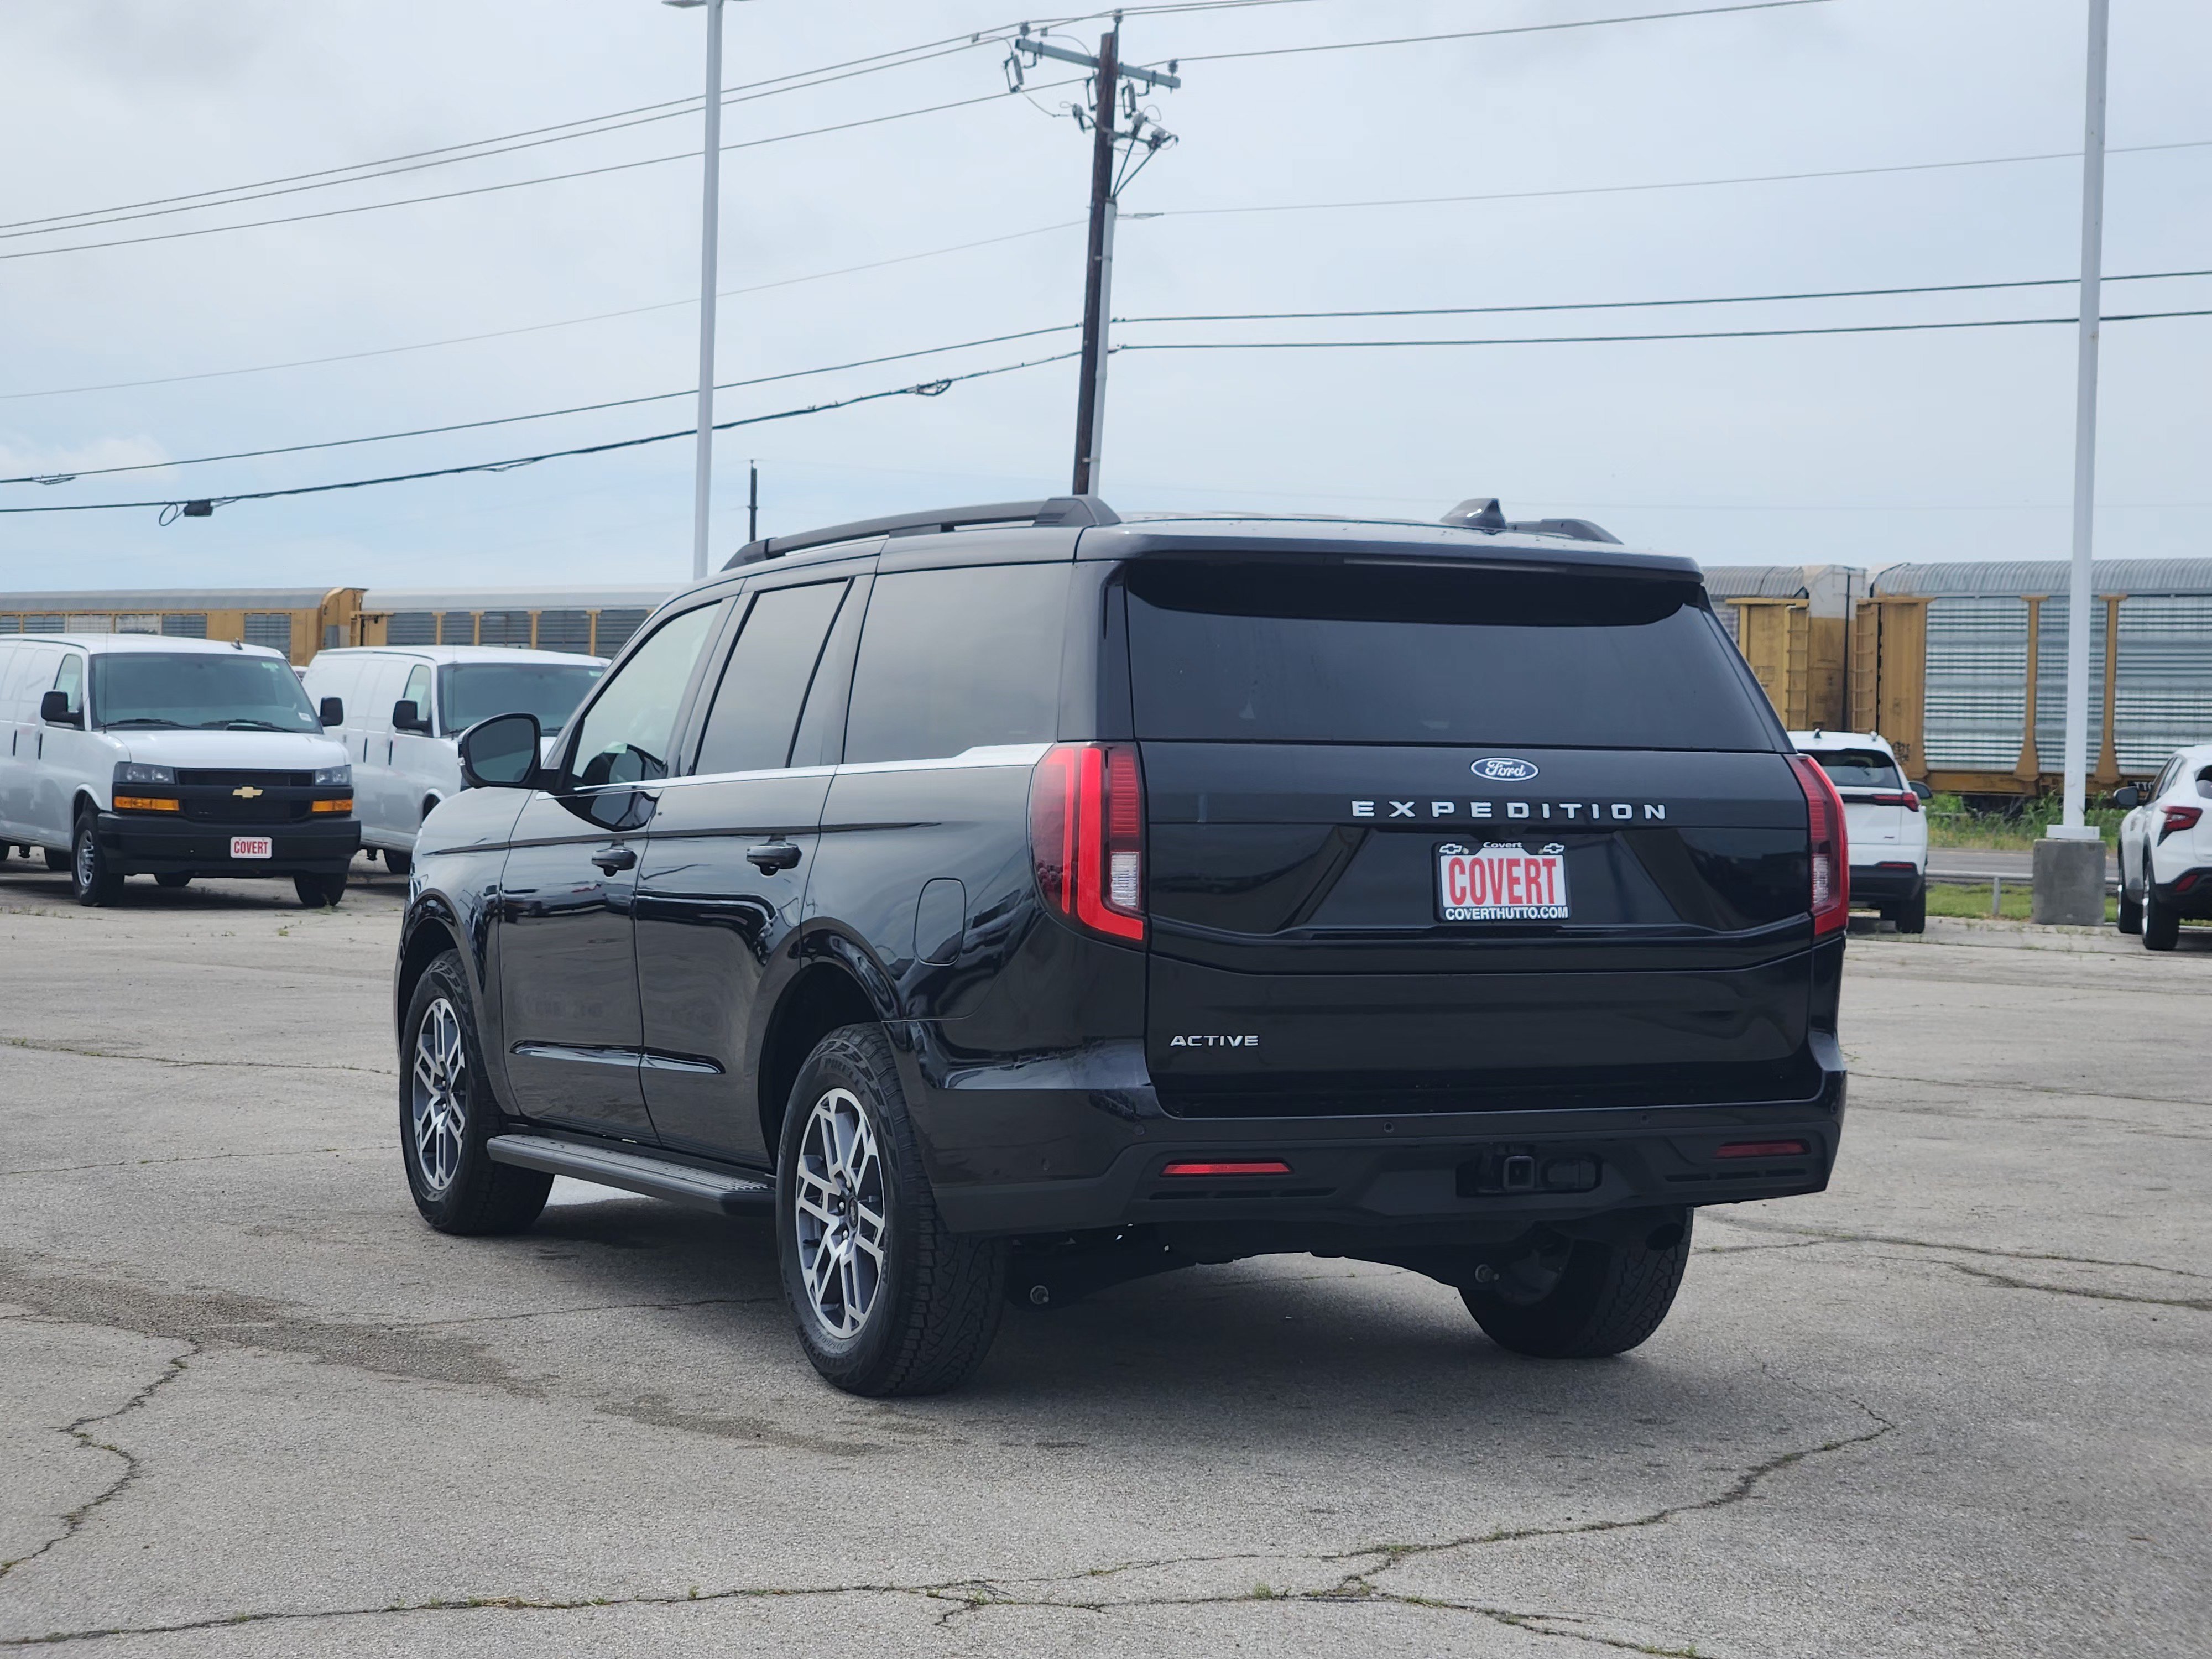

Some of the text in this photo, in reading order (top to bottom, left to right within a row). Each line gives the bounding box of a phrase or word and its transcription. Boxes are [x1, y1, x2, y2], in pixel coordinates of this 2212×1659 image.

[1485, 760, 1526, 776] Ford
[1351, 800, 1666, 821] EXPEDITION
[234, 841, 268, 854] COVERT
[1448, 857, 1557, 905] COVERT
[1445, 906, 1569, 921] COVERTHUTTO.COM
[1170, 1035, 1258, 1047] ACTIVE
